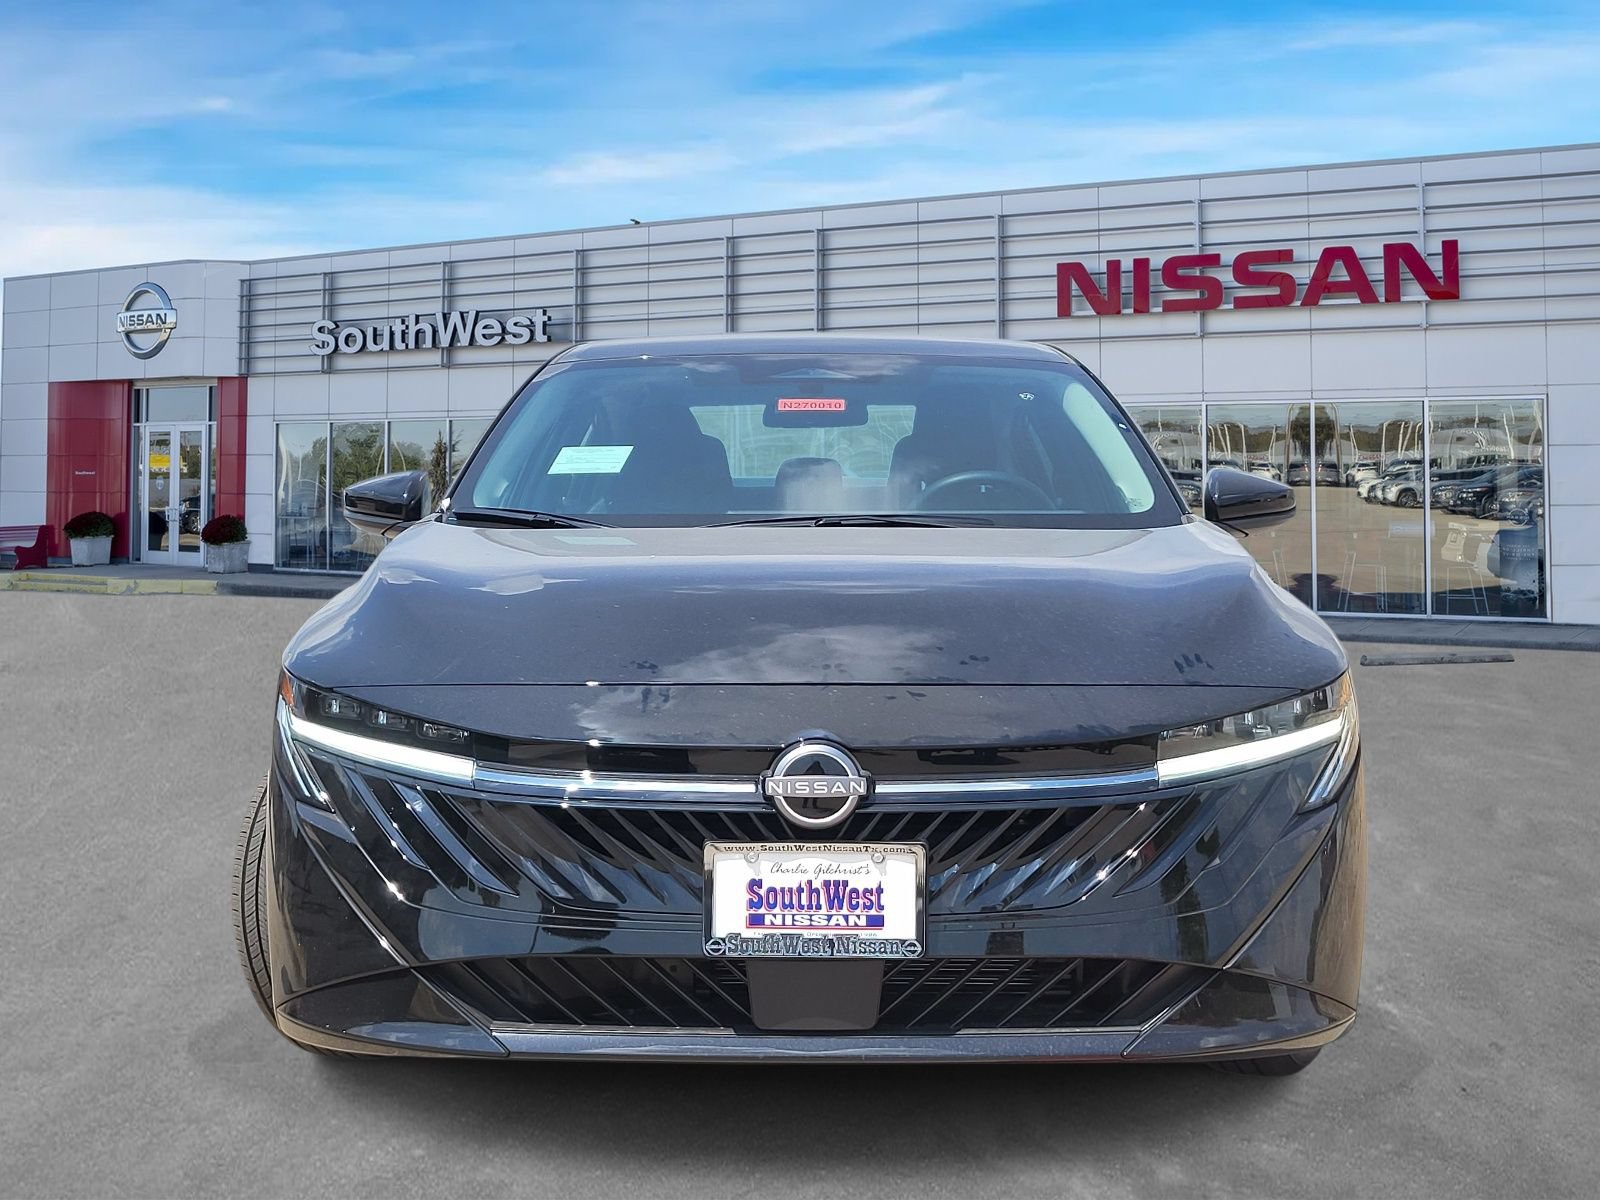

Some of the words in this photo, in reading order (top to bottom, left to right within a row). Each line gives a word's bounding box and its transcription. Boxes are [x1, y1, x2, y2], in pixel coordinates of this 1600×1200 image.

[1056, 239, 1461, 318] NISSAN
[119, 312, 168, 328] NISSAN
[309, 308, 551, 356] SouthWest
[768, 781, 864, 794] NISSAN
[770, 862, 809, 874] Charlie
[813, 863, 871, 880] Gilchrist's
[746, 878, 885, 913] SouthWest
[763, 914, 867, 927] NISSAN
[725, 934, 834, 955] SouthWest
[835, 936, 901, 955] Nissan
